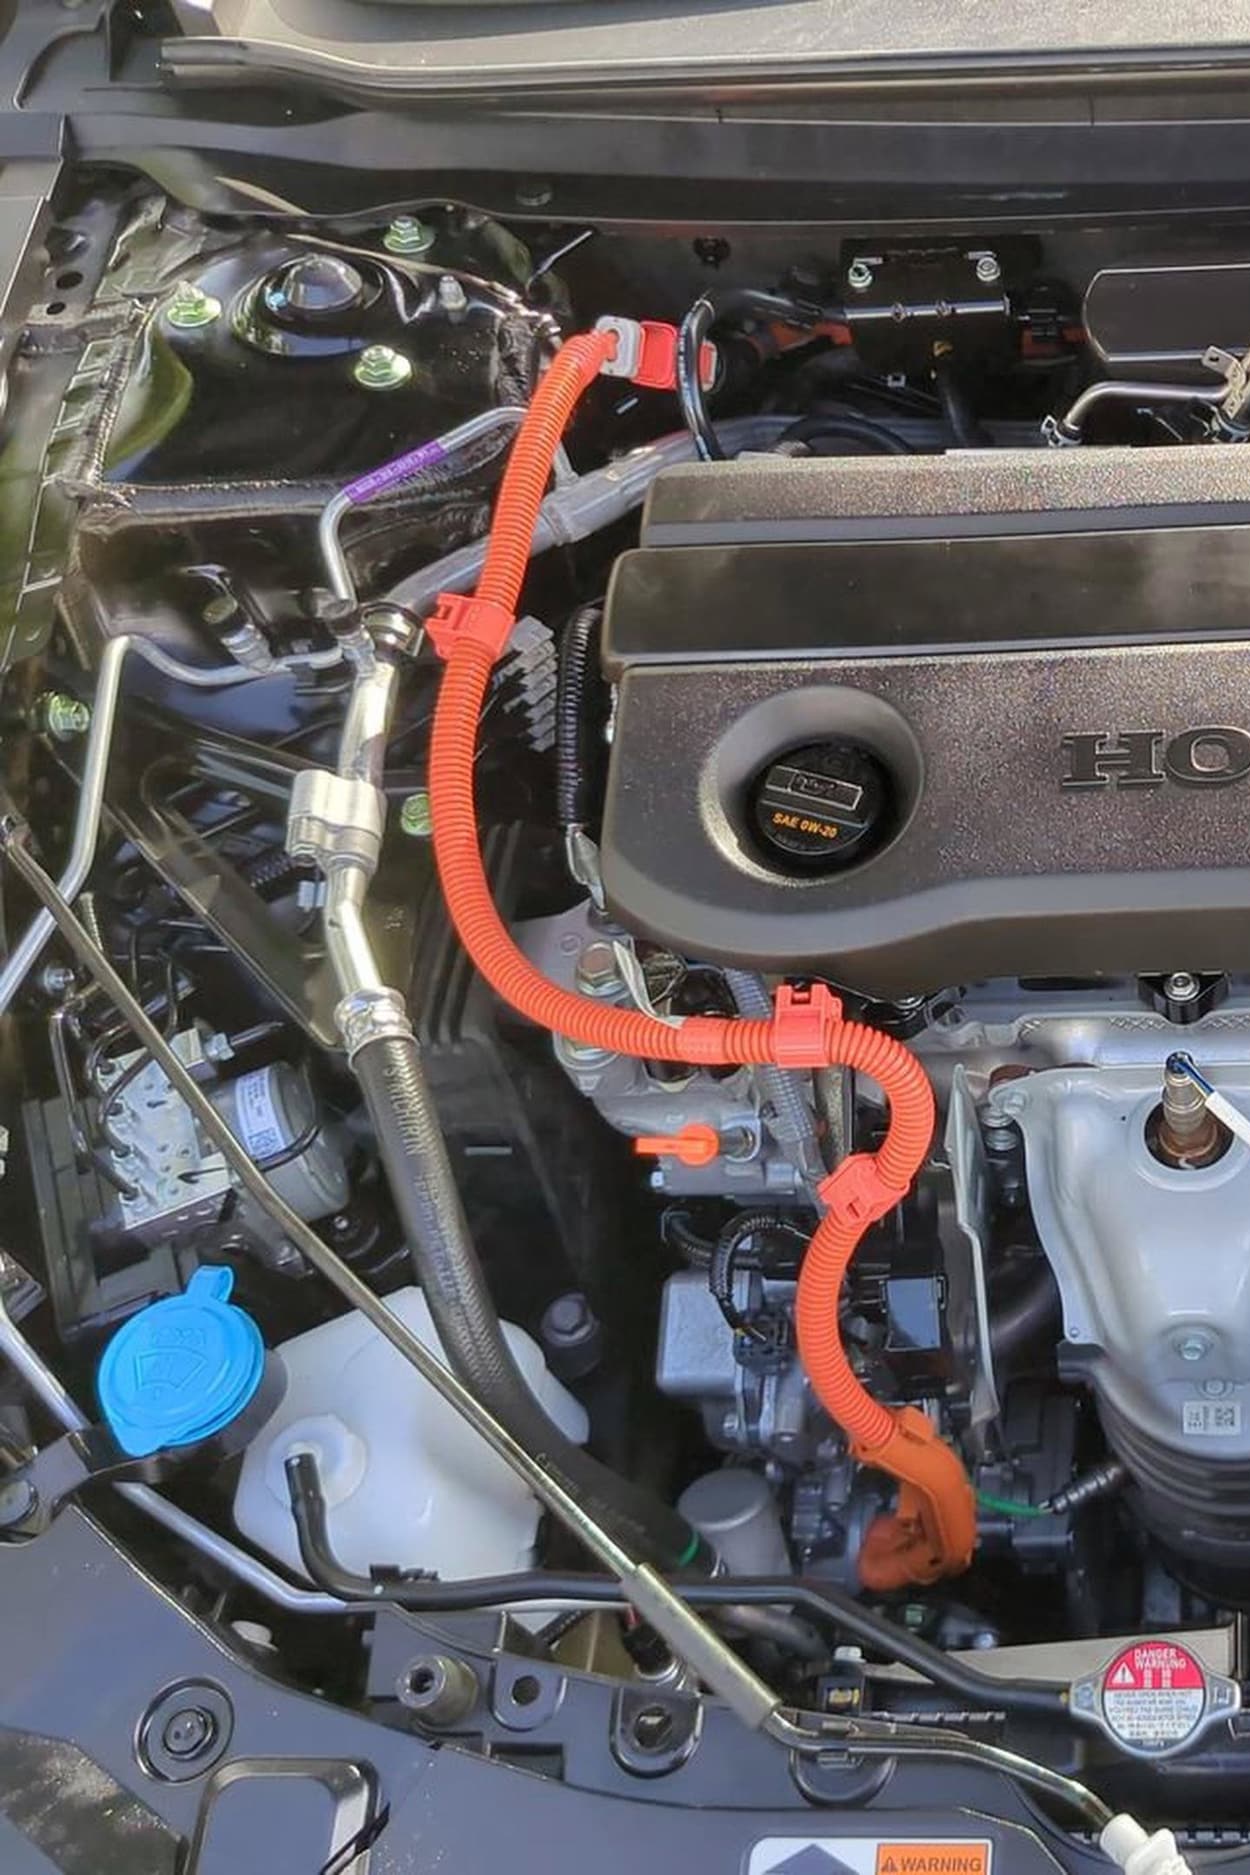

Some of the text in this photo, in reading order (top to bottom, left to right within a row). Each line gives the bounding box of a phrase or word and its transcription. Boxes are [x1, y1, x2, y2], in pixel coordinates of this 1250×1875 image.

[772, 812, 838, 838] SAE 0W-20
[1134, 1648, 1177, 1660] DANGER
[1134, 1658, 1187, 1670] WARNING
[901, 1856, 982, 1873] WARNING
